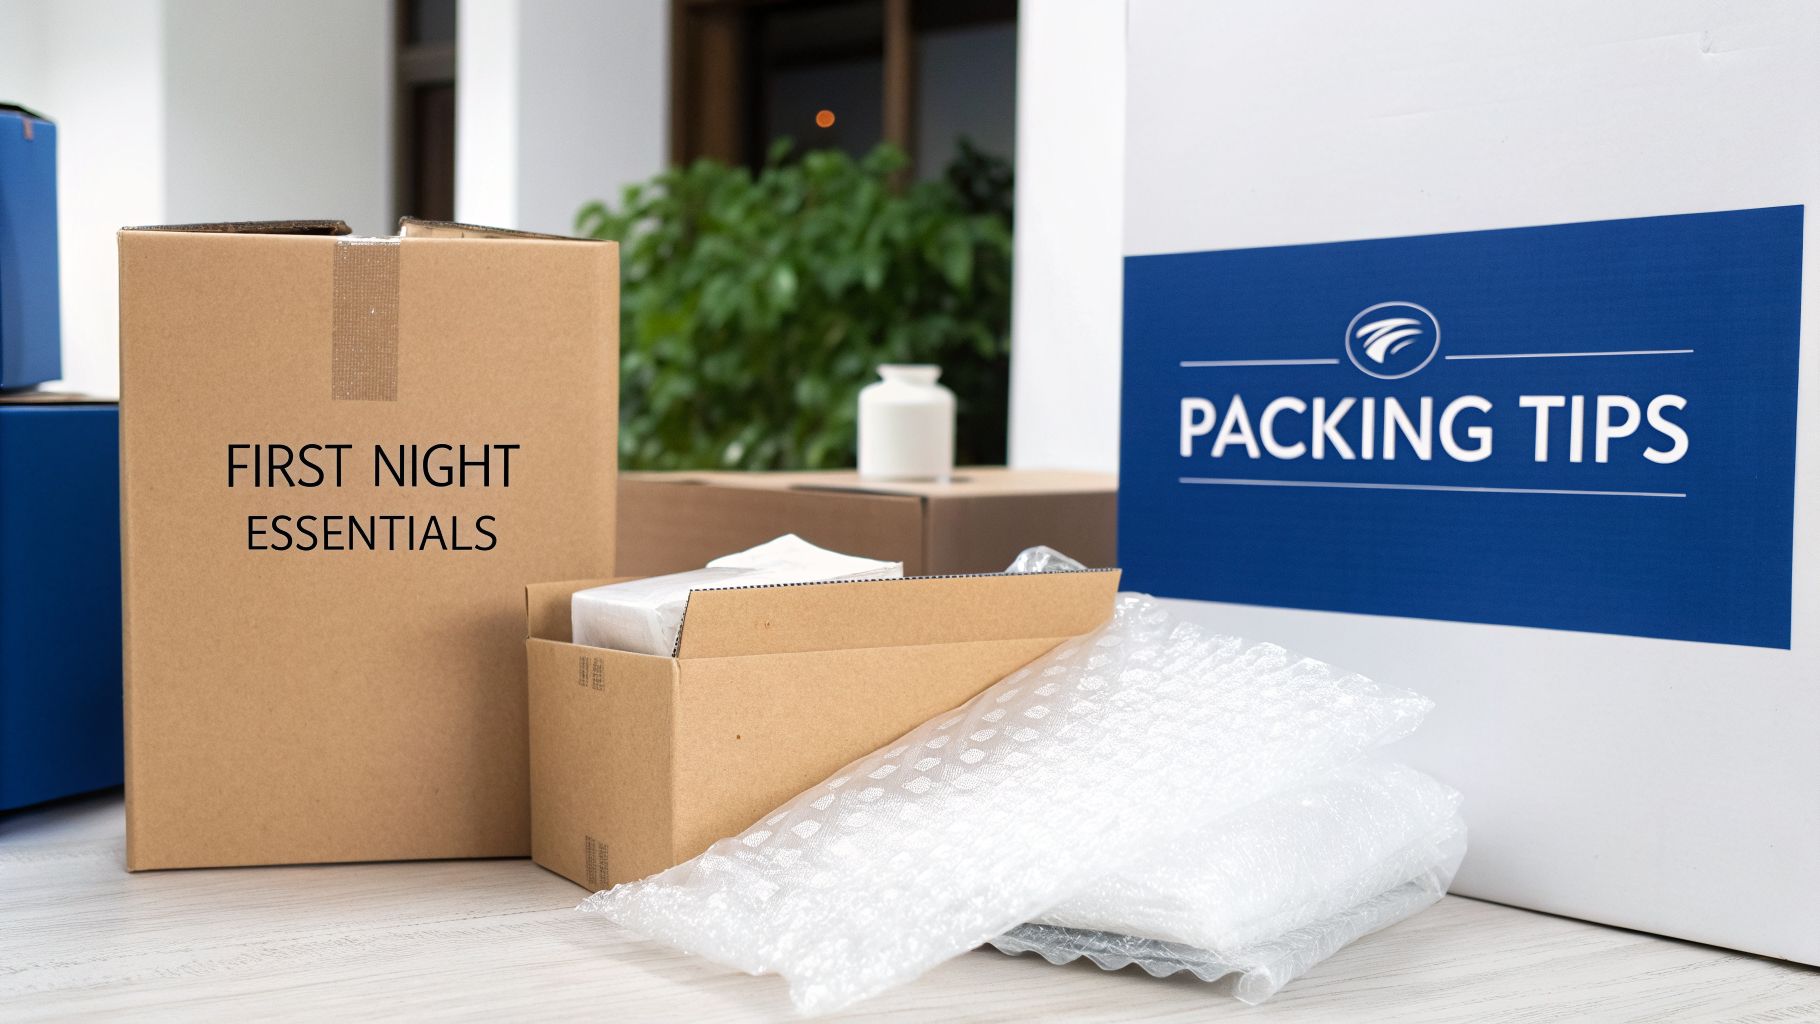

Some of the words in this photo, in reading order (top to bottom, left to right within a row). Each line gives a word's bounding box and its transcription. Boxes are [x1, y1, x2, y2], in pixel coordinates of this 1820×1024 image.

[1179, 394, 1494, 463] PACKING
[1518, 394, 1690, 464] TIPS
[227, 442, 353, 489] FIRST
[374, 442, 522, 489] NIGHT
[247, 513, 498, 552] ESSENTIALS
